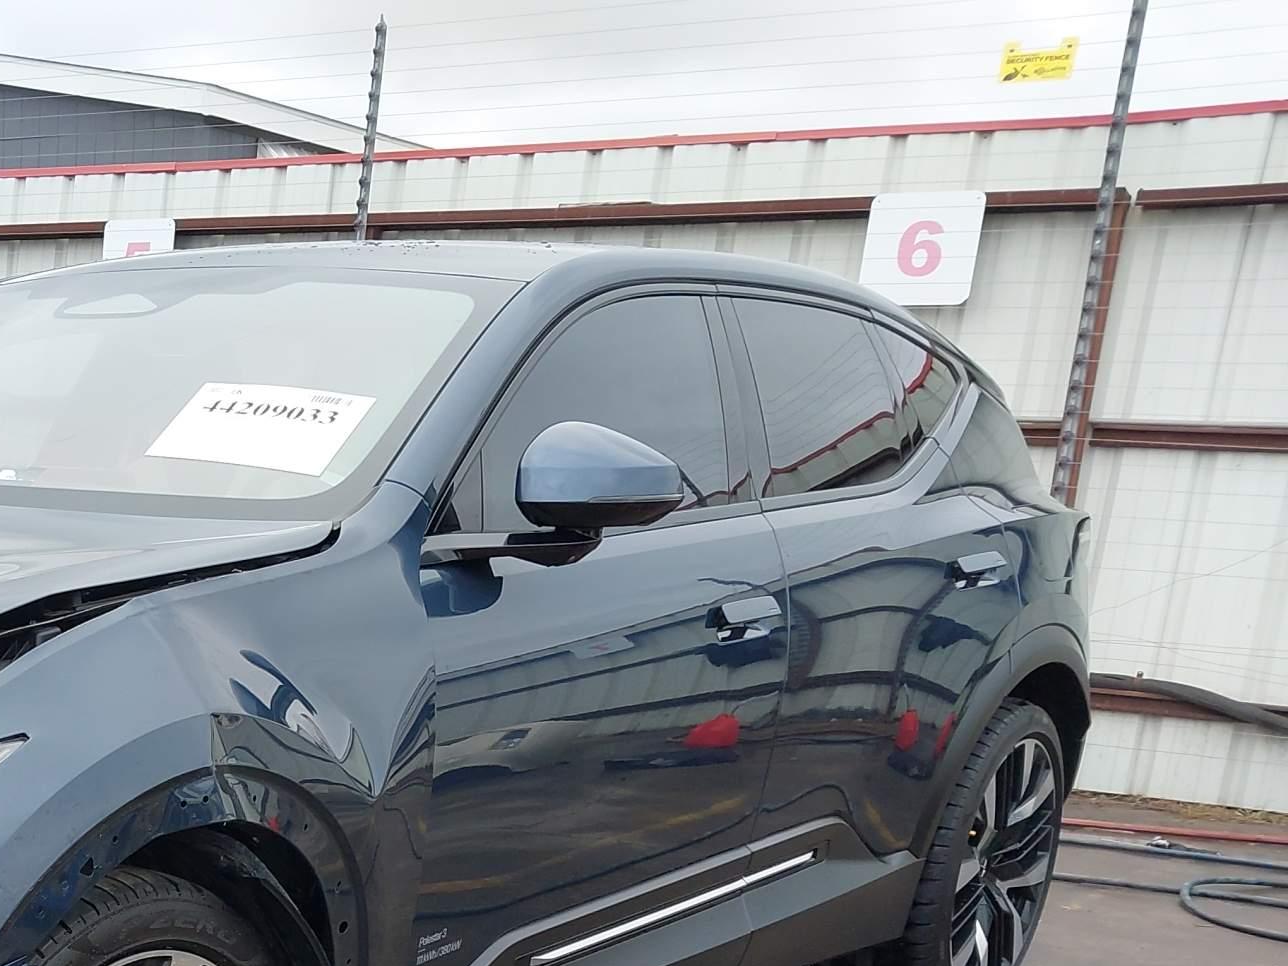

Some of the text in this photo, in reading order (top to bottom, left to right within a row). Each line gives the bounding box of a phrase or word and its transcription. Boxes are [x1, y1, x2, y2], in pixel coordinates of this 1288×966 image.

[1006, 56, 1044, 64] SECURITY
[1045, 54, 1070, 62] FENCE
[897, 220, 945, 277] 6
[203, 399, 339, 425] 44209033
